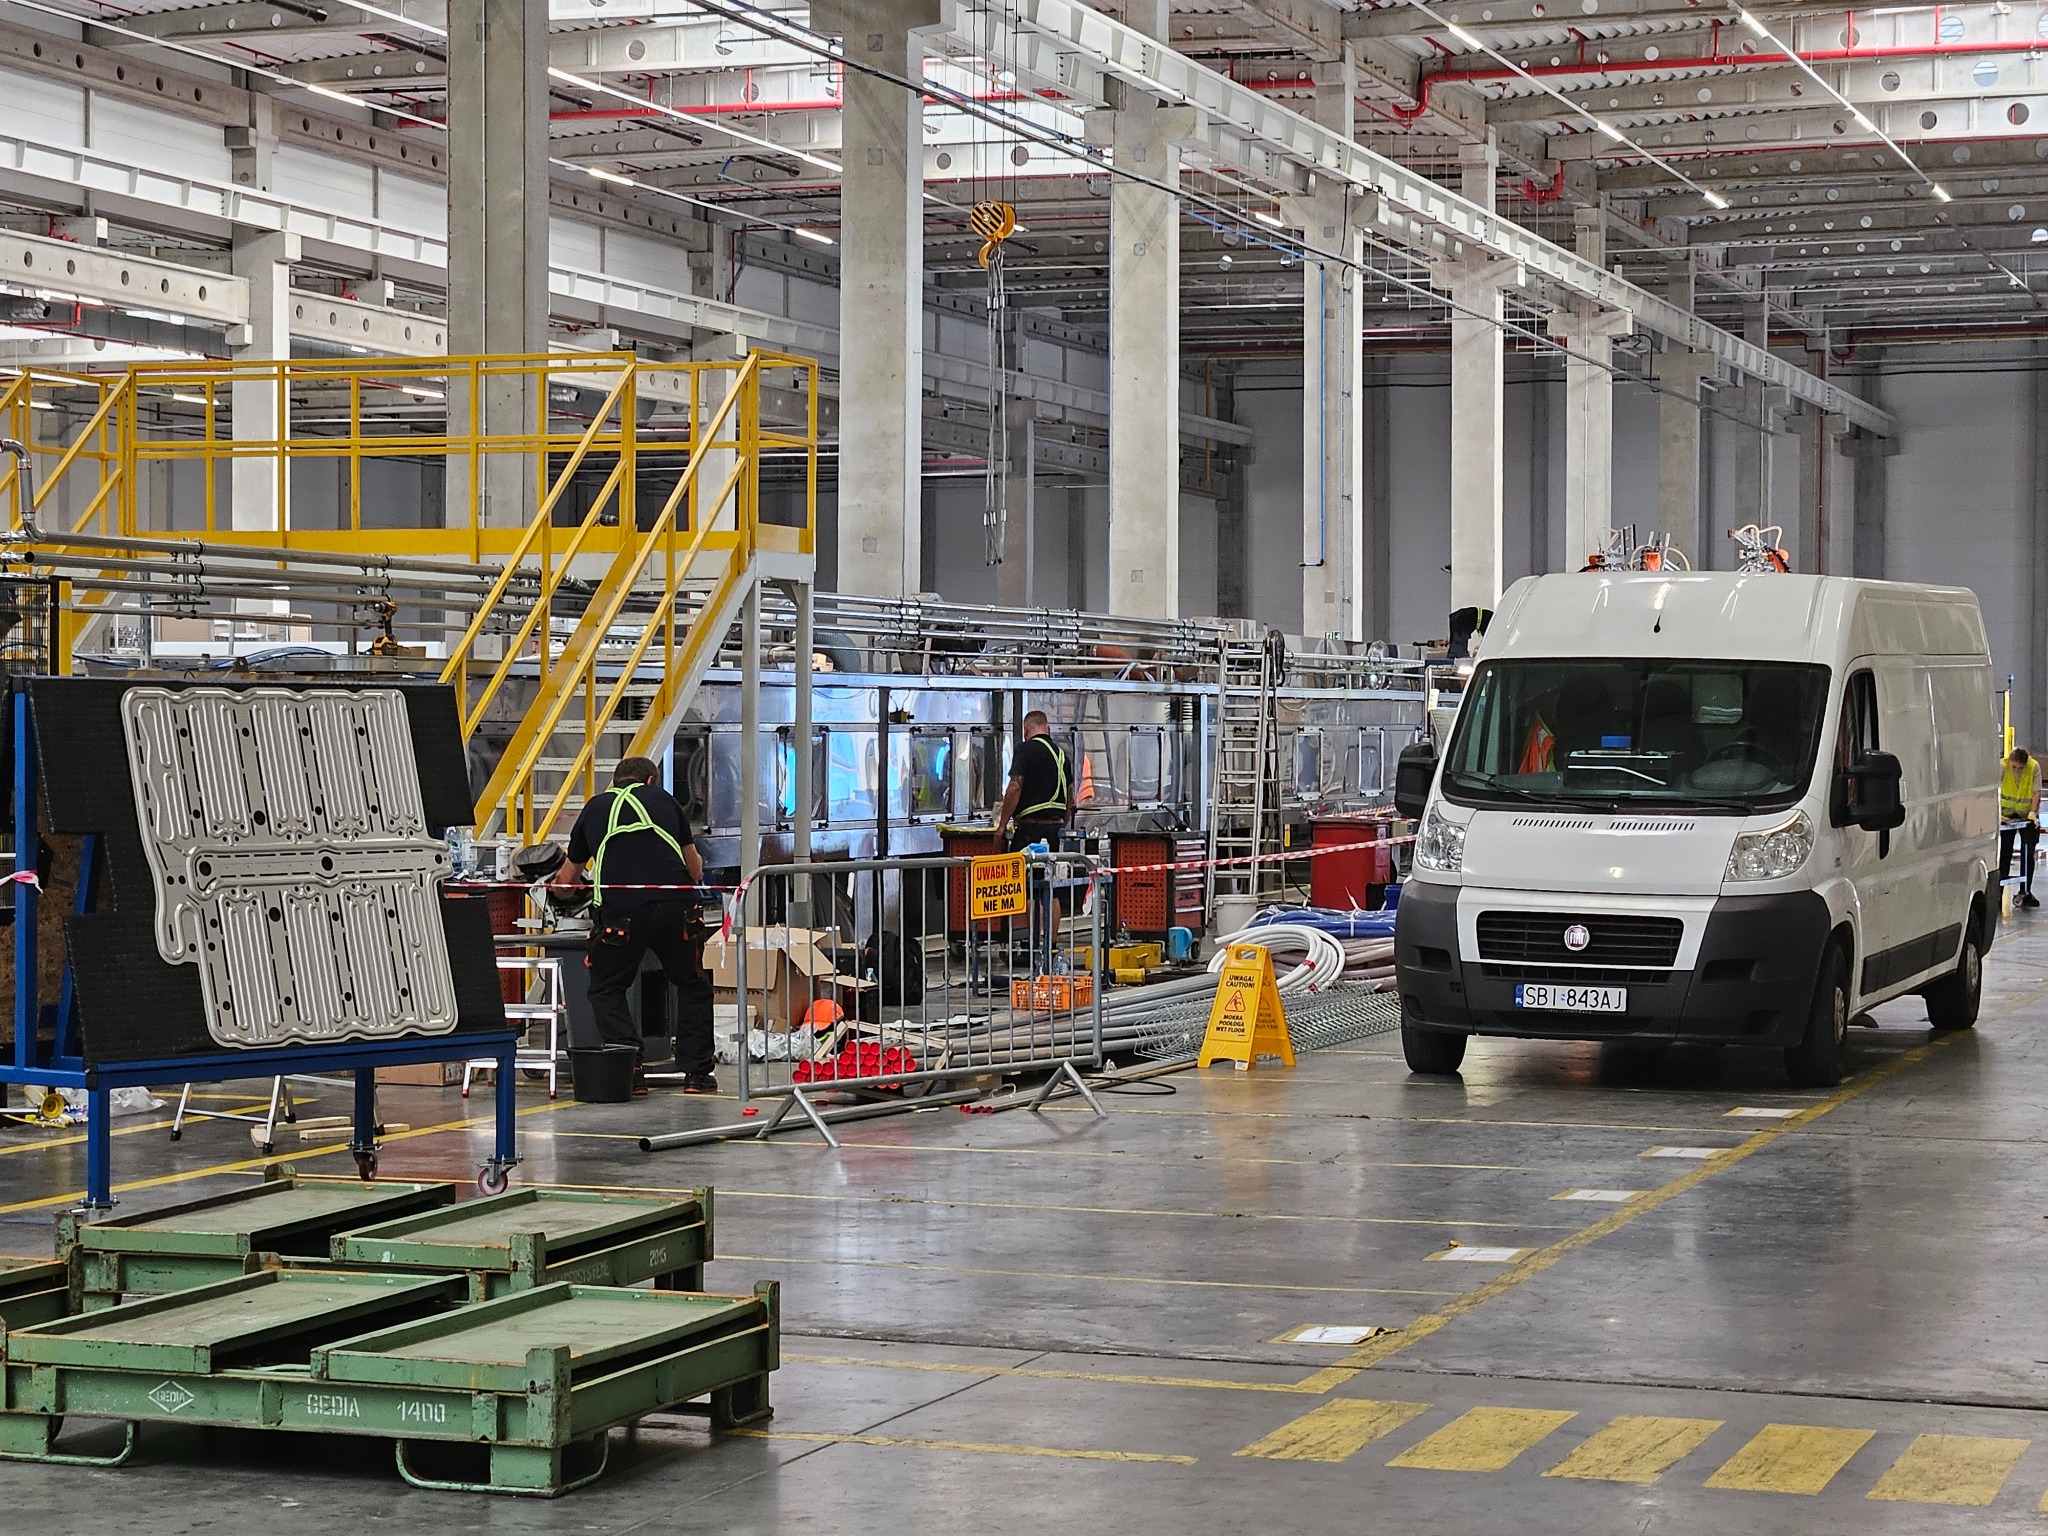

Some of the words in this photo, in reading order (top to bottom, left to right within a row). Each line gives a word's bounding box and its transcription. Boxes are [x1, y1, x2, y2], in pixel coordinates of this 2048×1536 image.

[976, 864, 1009, 881] UWAGA!
[975, 880, 1022, 899] PRZEJŚCIA
[983, 899, 998, 912] NIE
[1001, 897, 1015, 910] MA
[1569, 932, 1585, 945] FIAT
[1229, 974, 1254, 982] UWAGA!
[1525, 987, 1557, 1006] SBI
[1566, 988, 1622, 1009] 843AJ
[156, 1390, 186, 1403] GEDIA
[307, 1393, 360, 1418] GEDIA
[396, 1401, 446, 1423] 1400
